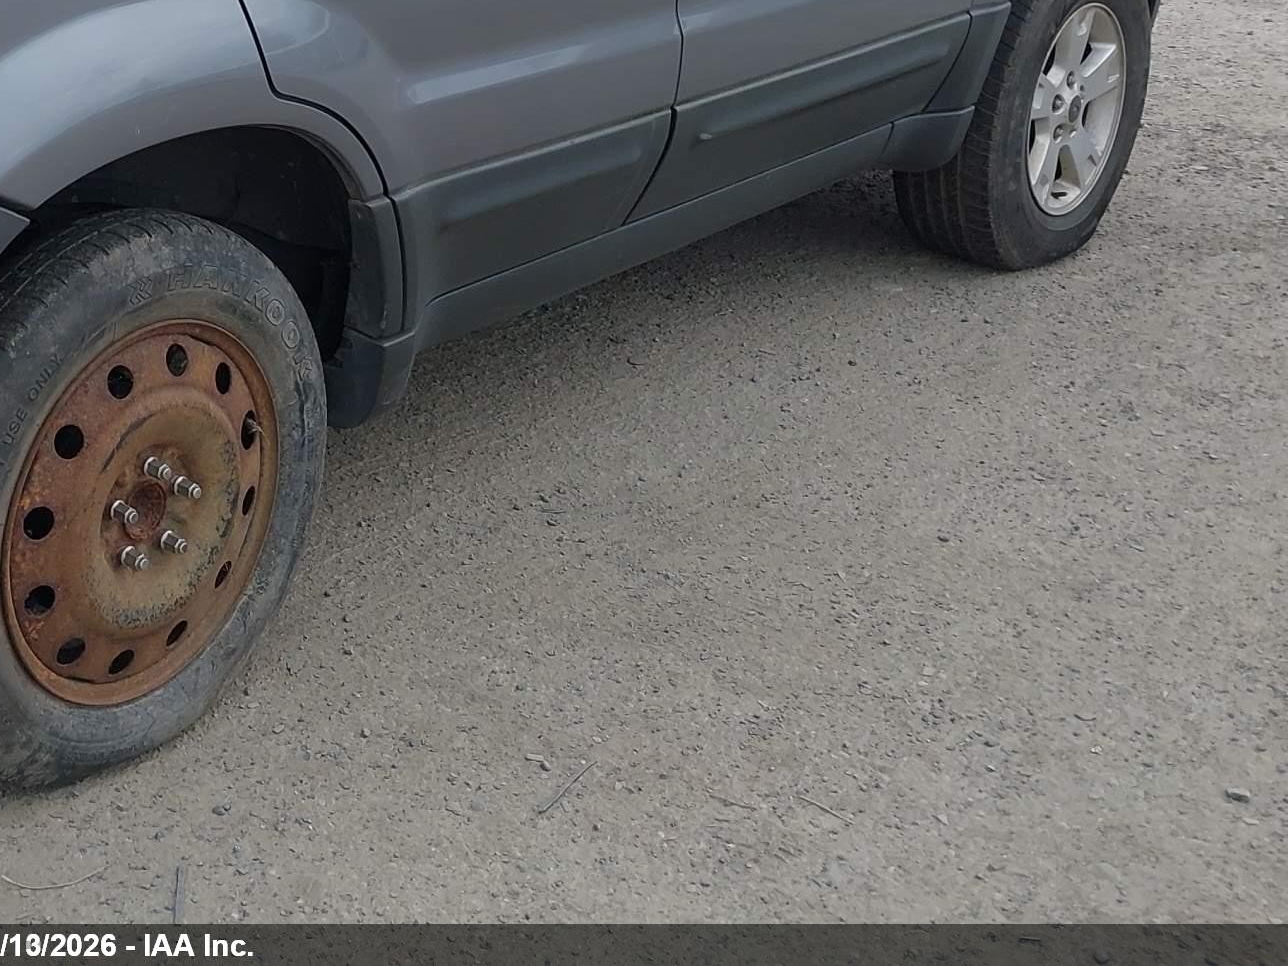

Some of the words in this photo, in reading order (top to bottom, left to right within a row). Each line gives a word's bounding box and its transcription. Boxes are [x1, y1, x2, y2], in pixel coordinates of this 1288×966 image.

[166, 261, 314, 383] HANKOOK
[3, 407, 29, 447] USE
[27, 353, 62, 403] ONLY
